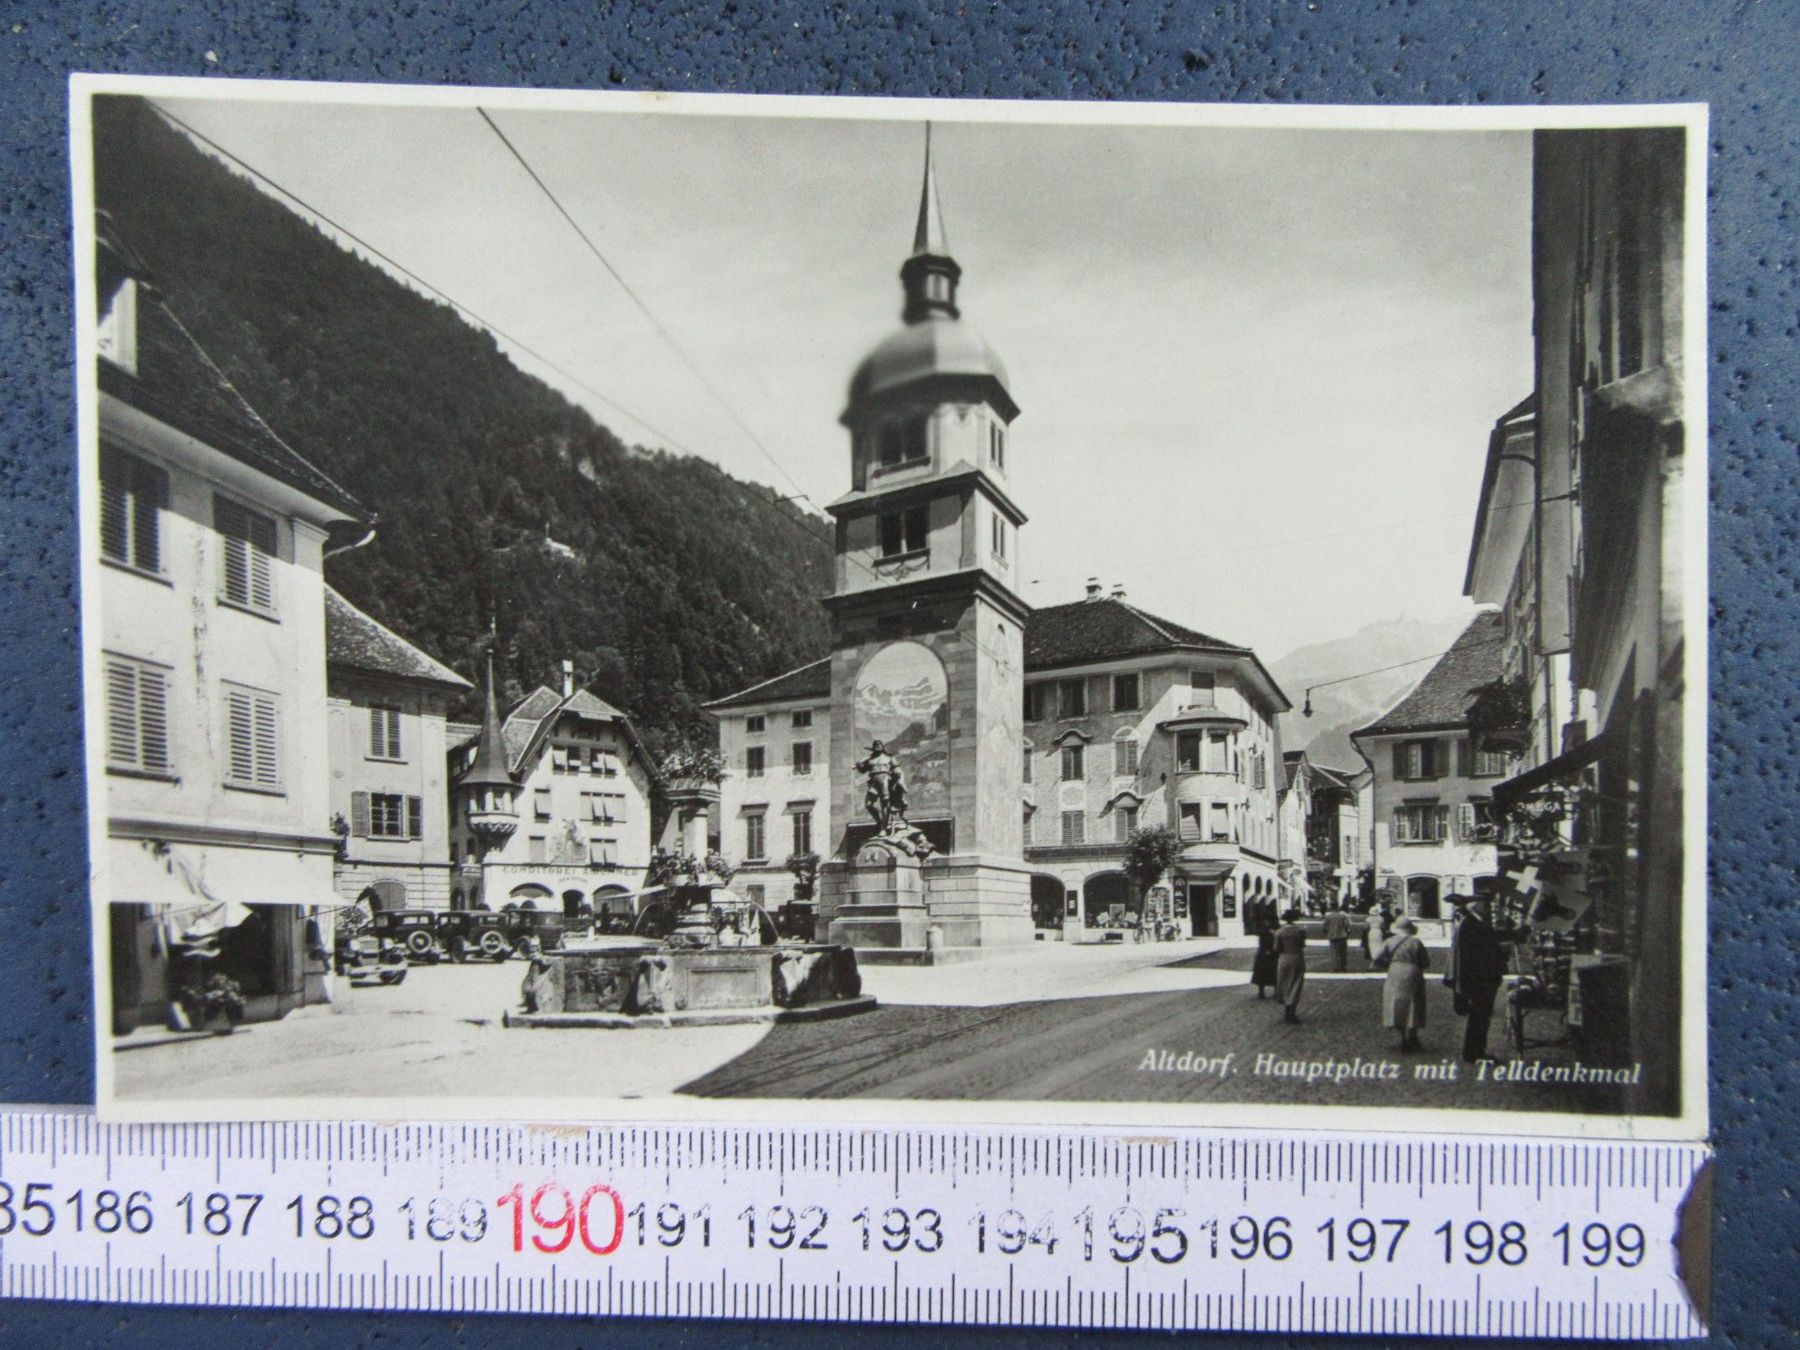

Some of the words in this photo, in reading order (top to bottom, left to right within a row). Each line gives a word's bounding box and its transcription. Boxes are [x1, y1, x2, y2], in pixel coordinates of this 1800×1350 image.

[1138, 1047, 1238, 1078] Altdorf.
[1253, 1053, 1401, 1083] Hauptplatz
[1413, 1059, 1458, 1081] mit
[1475, 1058, 1643, 1085] Telldenkmal
[66, 1188, 154, 1234] 186
[176, 1191, 265, 1237] 187
[286, 1194, 375, 1240] 188
[397, 1196, 488, 1243] 189
[496, 1181, 625, 1256] 190
[627, 1202, 711, 1249] 191
[737, 1204, 829, 1250] 192
[852, 1206, 944, 1253] 193
[967, 1205, 1059, 1256] 194
[1072, 1204, 1189, 1265] 195
[1199, 1214, 1293, 1262] 196
[1316, 1217, 1411, 1263] 197
[1434, 1219, 1529, 1267] 198
[1552, 1221, 1647, 1269] 199
